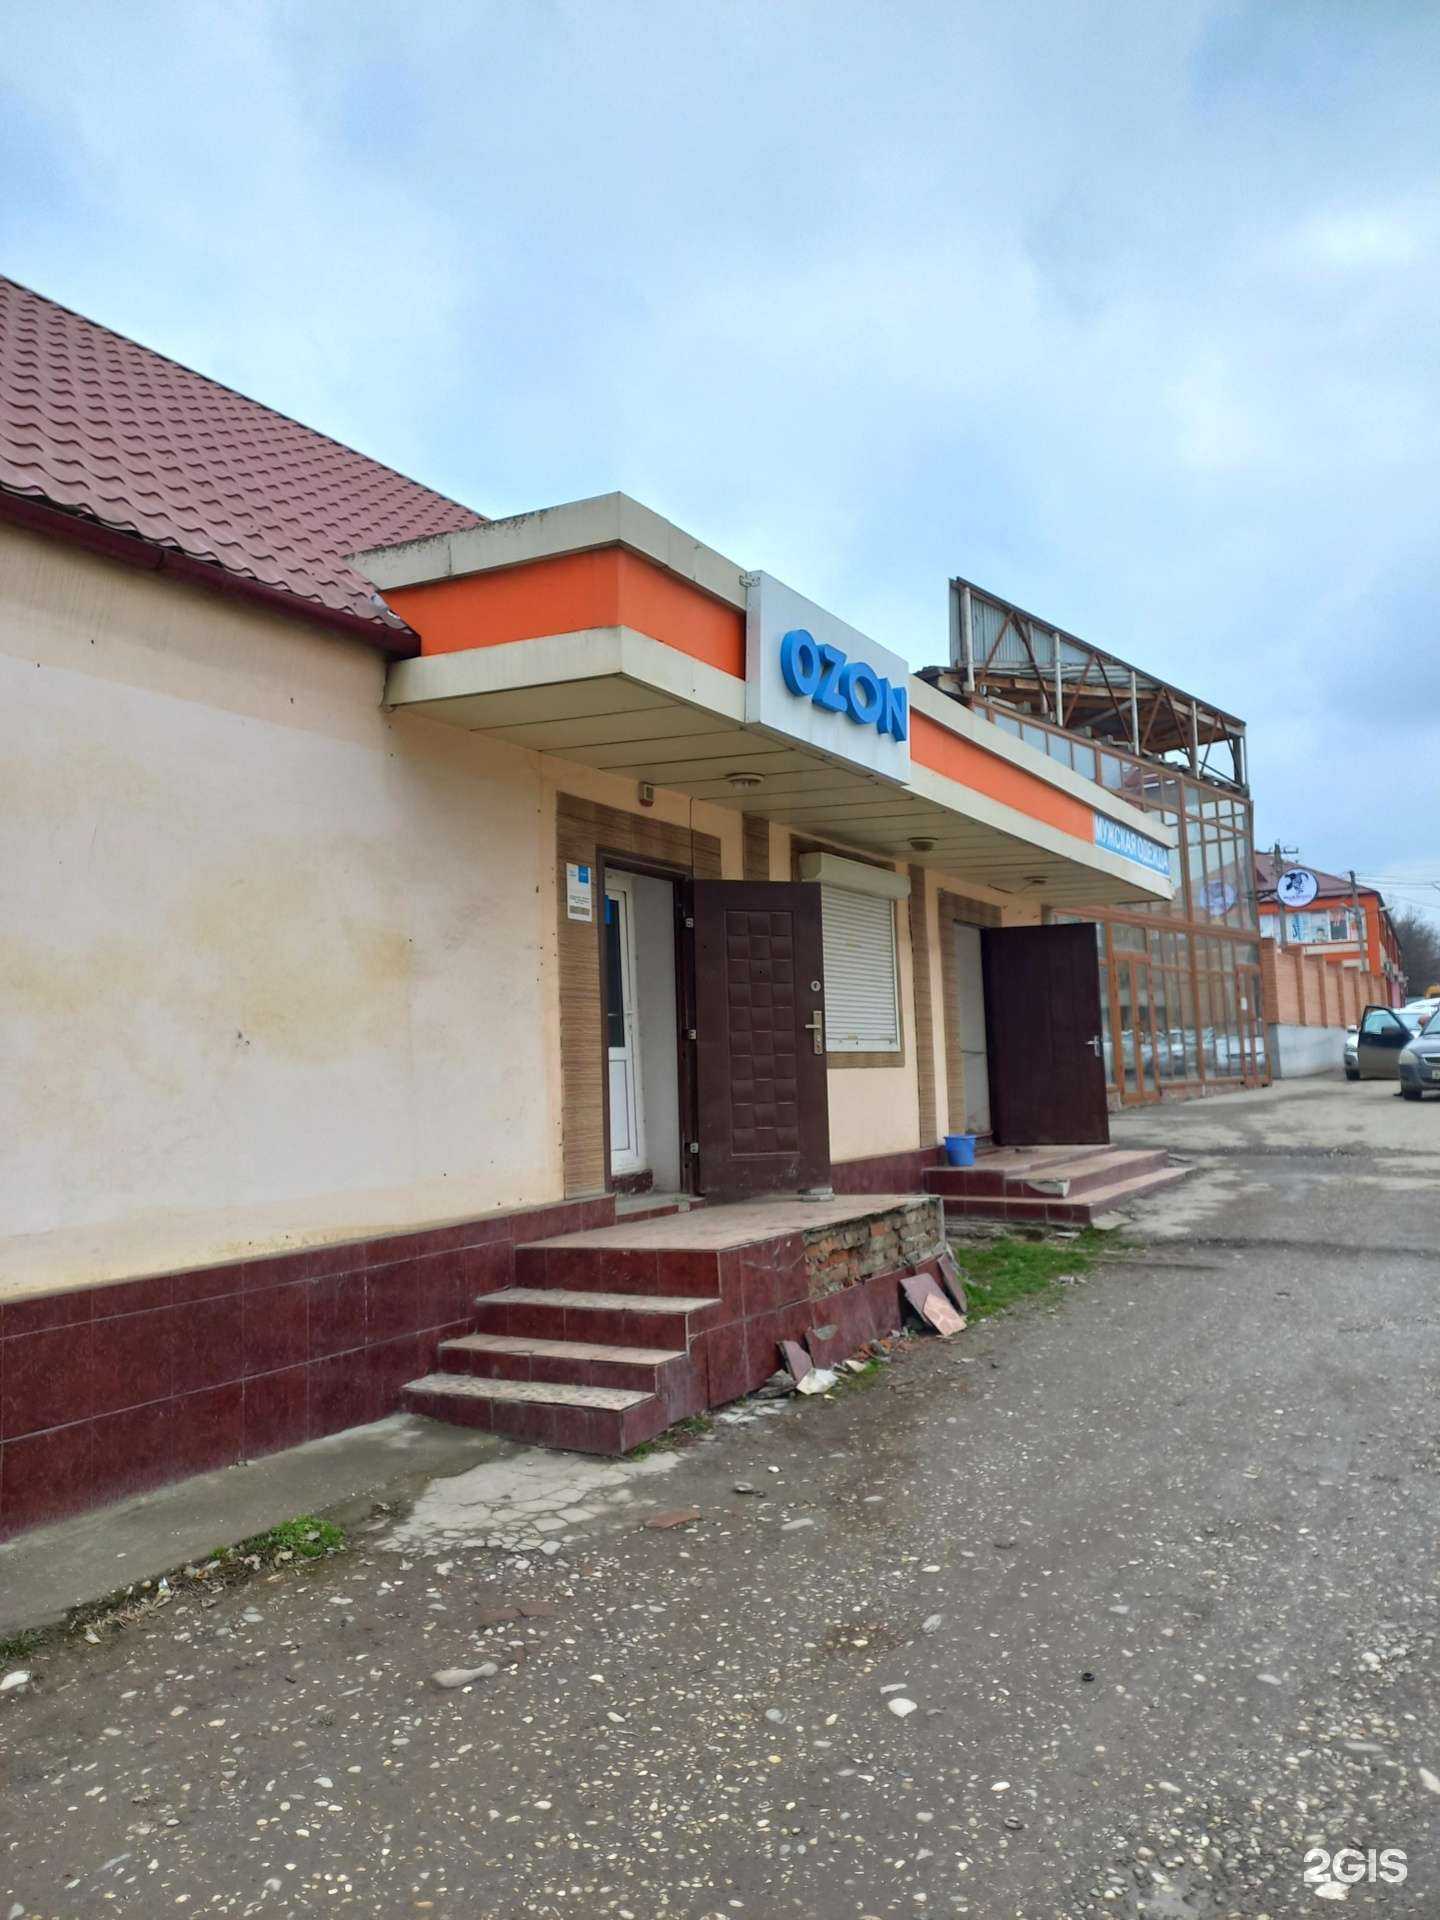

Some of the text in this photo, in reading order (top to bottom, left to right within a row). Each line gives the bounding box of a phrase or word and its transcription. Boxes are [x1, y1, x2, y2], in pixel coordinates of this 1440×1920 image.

[781, 629, 907, 742] OZON
[1096, 814, 1168, 871] МУЖСКАЯ ОДЕЖДА
